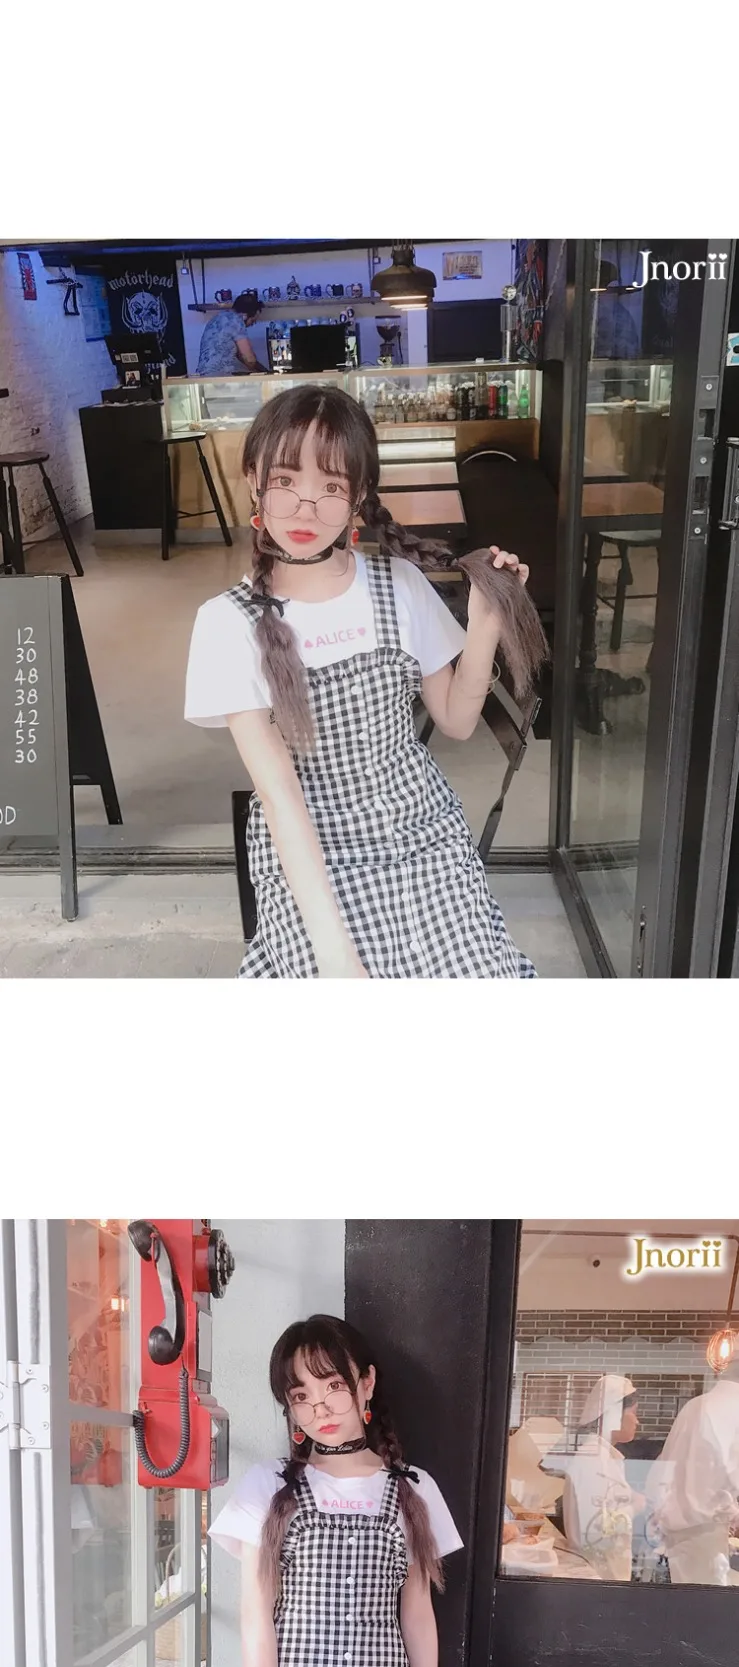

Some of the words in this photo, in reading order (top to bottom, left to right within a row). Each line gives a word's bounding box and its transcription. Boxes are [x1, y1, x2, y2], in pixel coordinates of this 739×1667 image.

[17, 626, 36, 645] 12
[316, 628, 357, 648] ALICE
[16, 648, 37, 664] 30
[15, 667, 39, 686] 48
[15, 688, 39, 706] 38
[14, 709, 40, 728] 42
[15, 728, 37, 744] 55
[15, 749, 37, 763] 30
[330, 1499, 365, 1510] ALICE
